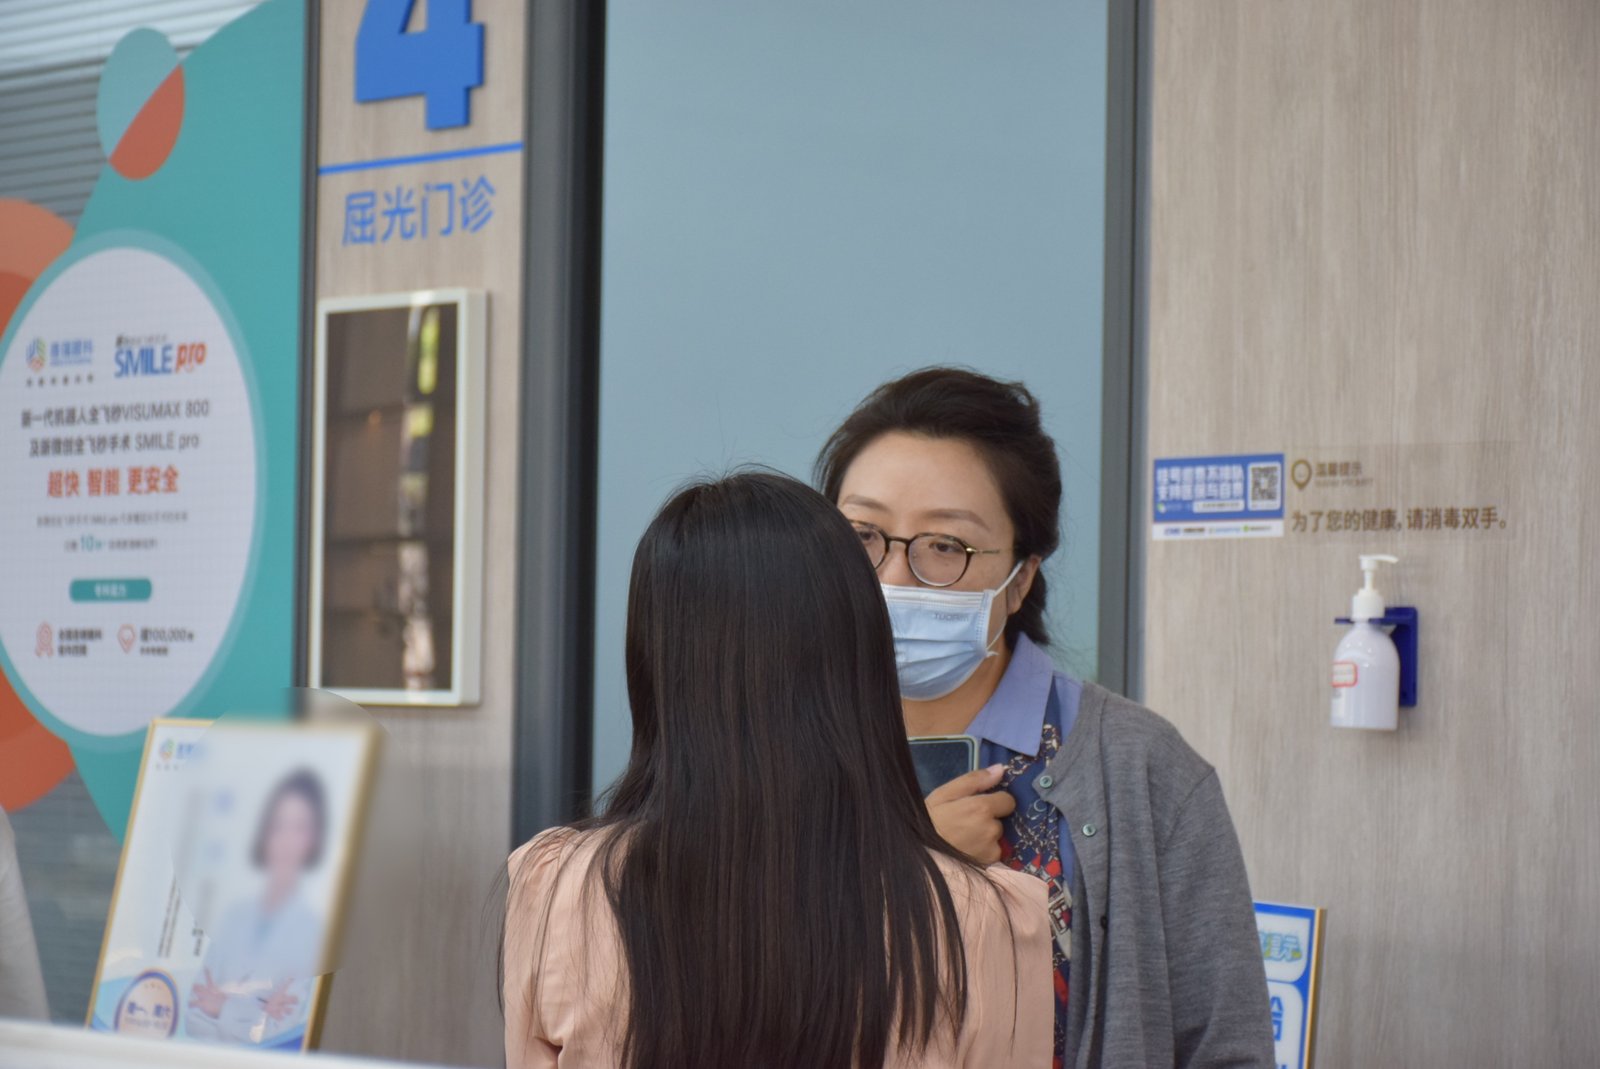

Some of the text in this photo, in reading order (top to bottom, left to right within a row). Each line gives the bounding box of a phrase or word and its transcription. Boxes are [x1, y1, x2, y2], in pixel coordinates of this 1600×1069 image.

[354, 0, 486, 131] 4
[341, 174, 496, 247] 屈光门诊
[113, 341, 207, 378] SMILE pro
[185, 399, 210, 418] 800
[134, 432, 176, 452] SMILE
[178, 432, 200, 452] pro
[47, 465, 179, 498] 超快 智能 更安全
